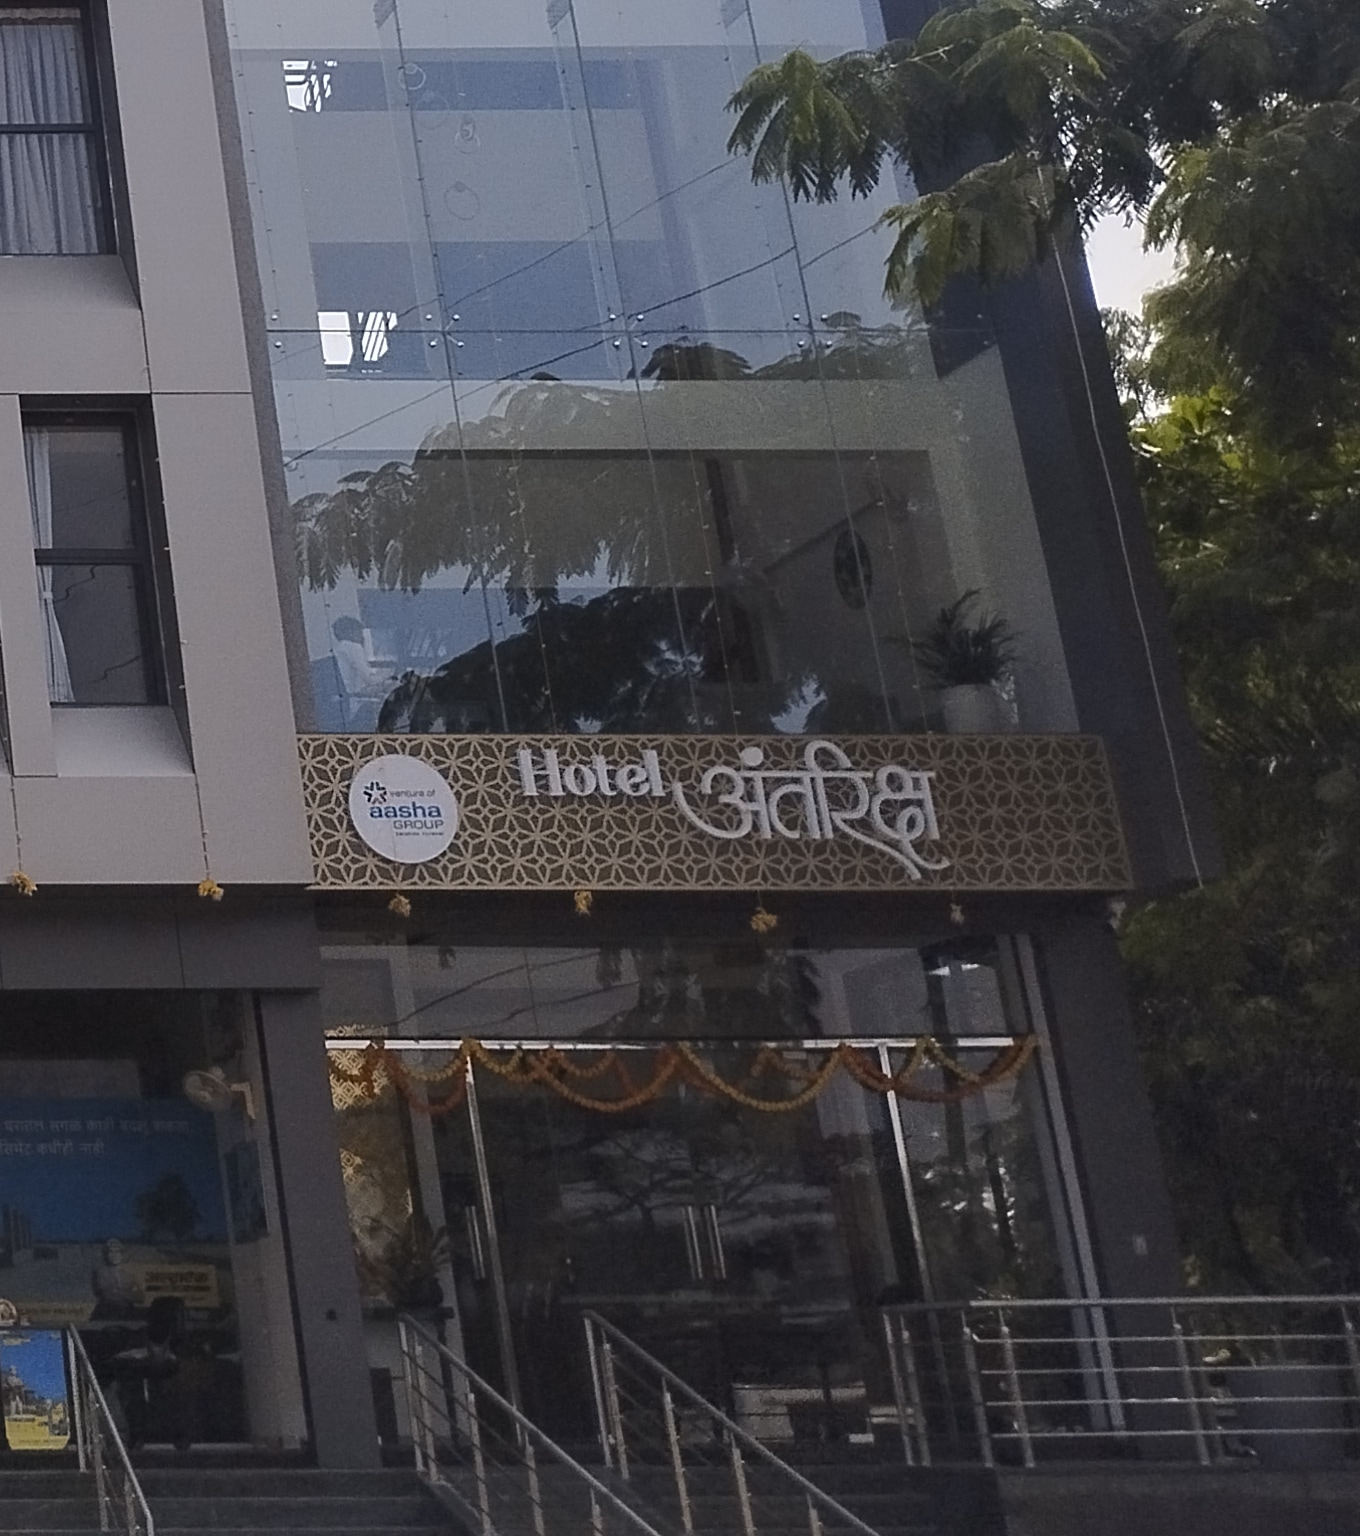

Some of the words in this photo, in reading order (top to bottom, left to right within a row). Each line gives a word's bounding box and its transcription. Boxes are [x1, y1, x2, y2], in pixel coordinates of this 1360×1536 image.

[517, 748, 666, 797] Hotel
[370, 801, 442, 818] aasha
[393, 819, 444, 830] GROUP
[672, 740, 950, 880] अंतरिक्ष
